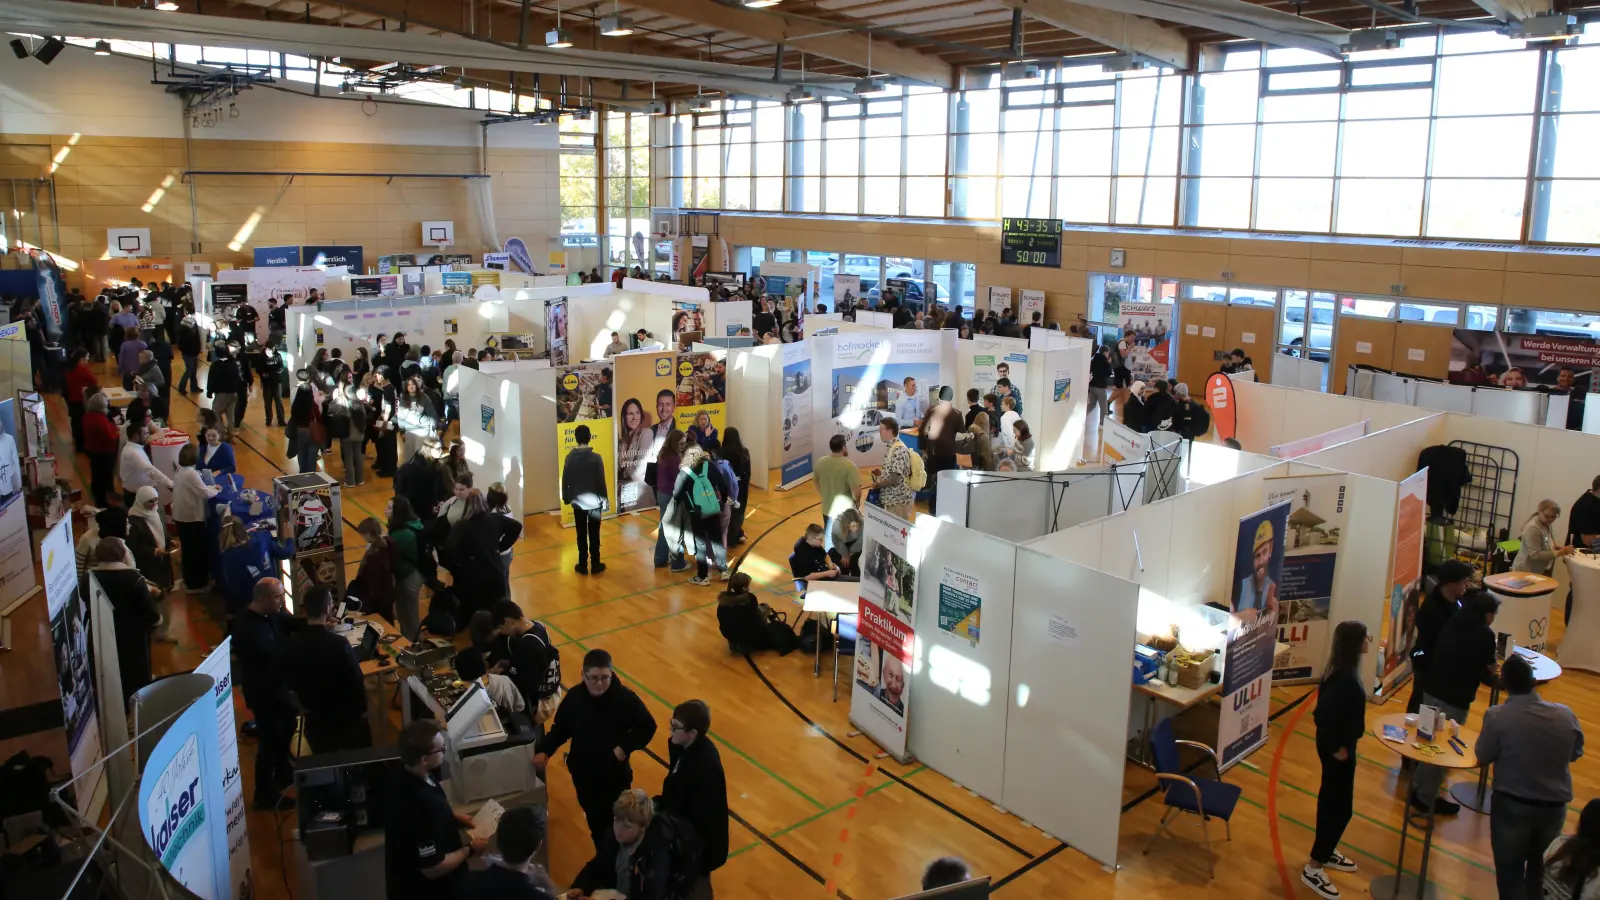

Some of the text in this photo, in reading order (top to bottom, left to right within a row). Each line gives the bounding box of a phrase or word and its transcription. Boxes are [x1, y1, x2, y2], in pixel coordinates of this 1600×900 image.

[1003, 219, 1062, 233] H 43-35 G
[1028, 237, 1035, 247] 2
[266, 257, 288, 265] Herzlich
[318, 255, 347, 264] Herzlich
[1523, 340, 1551, 349] Werde
[1541, 353, 1555, 362] bei
[1555, 356, 1590, 365] unseren
[955, 576, 979, 588] contact
[864, 606, 907, 643] Praktikum
[1233, 678, 1263, 711] ULLI
[151, 776, 200, 860] kaiser
